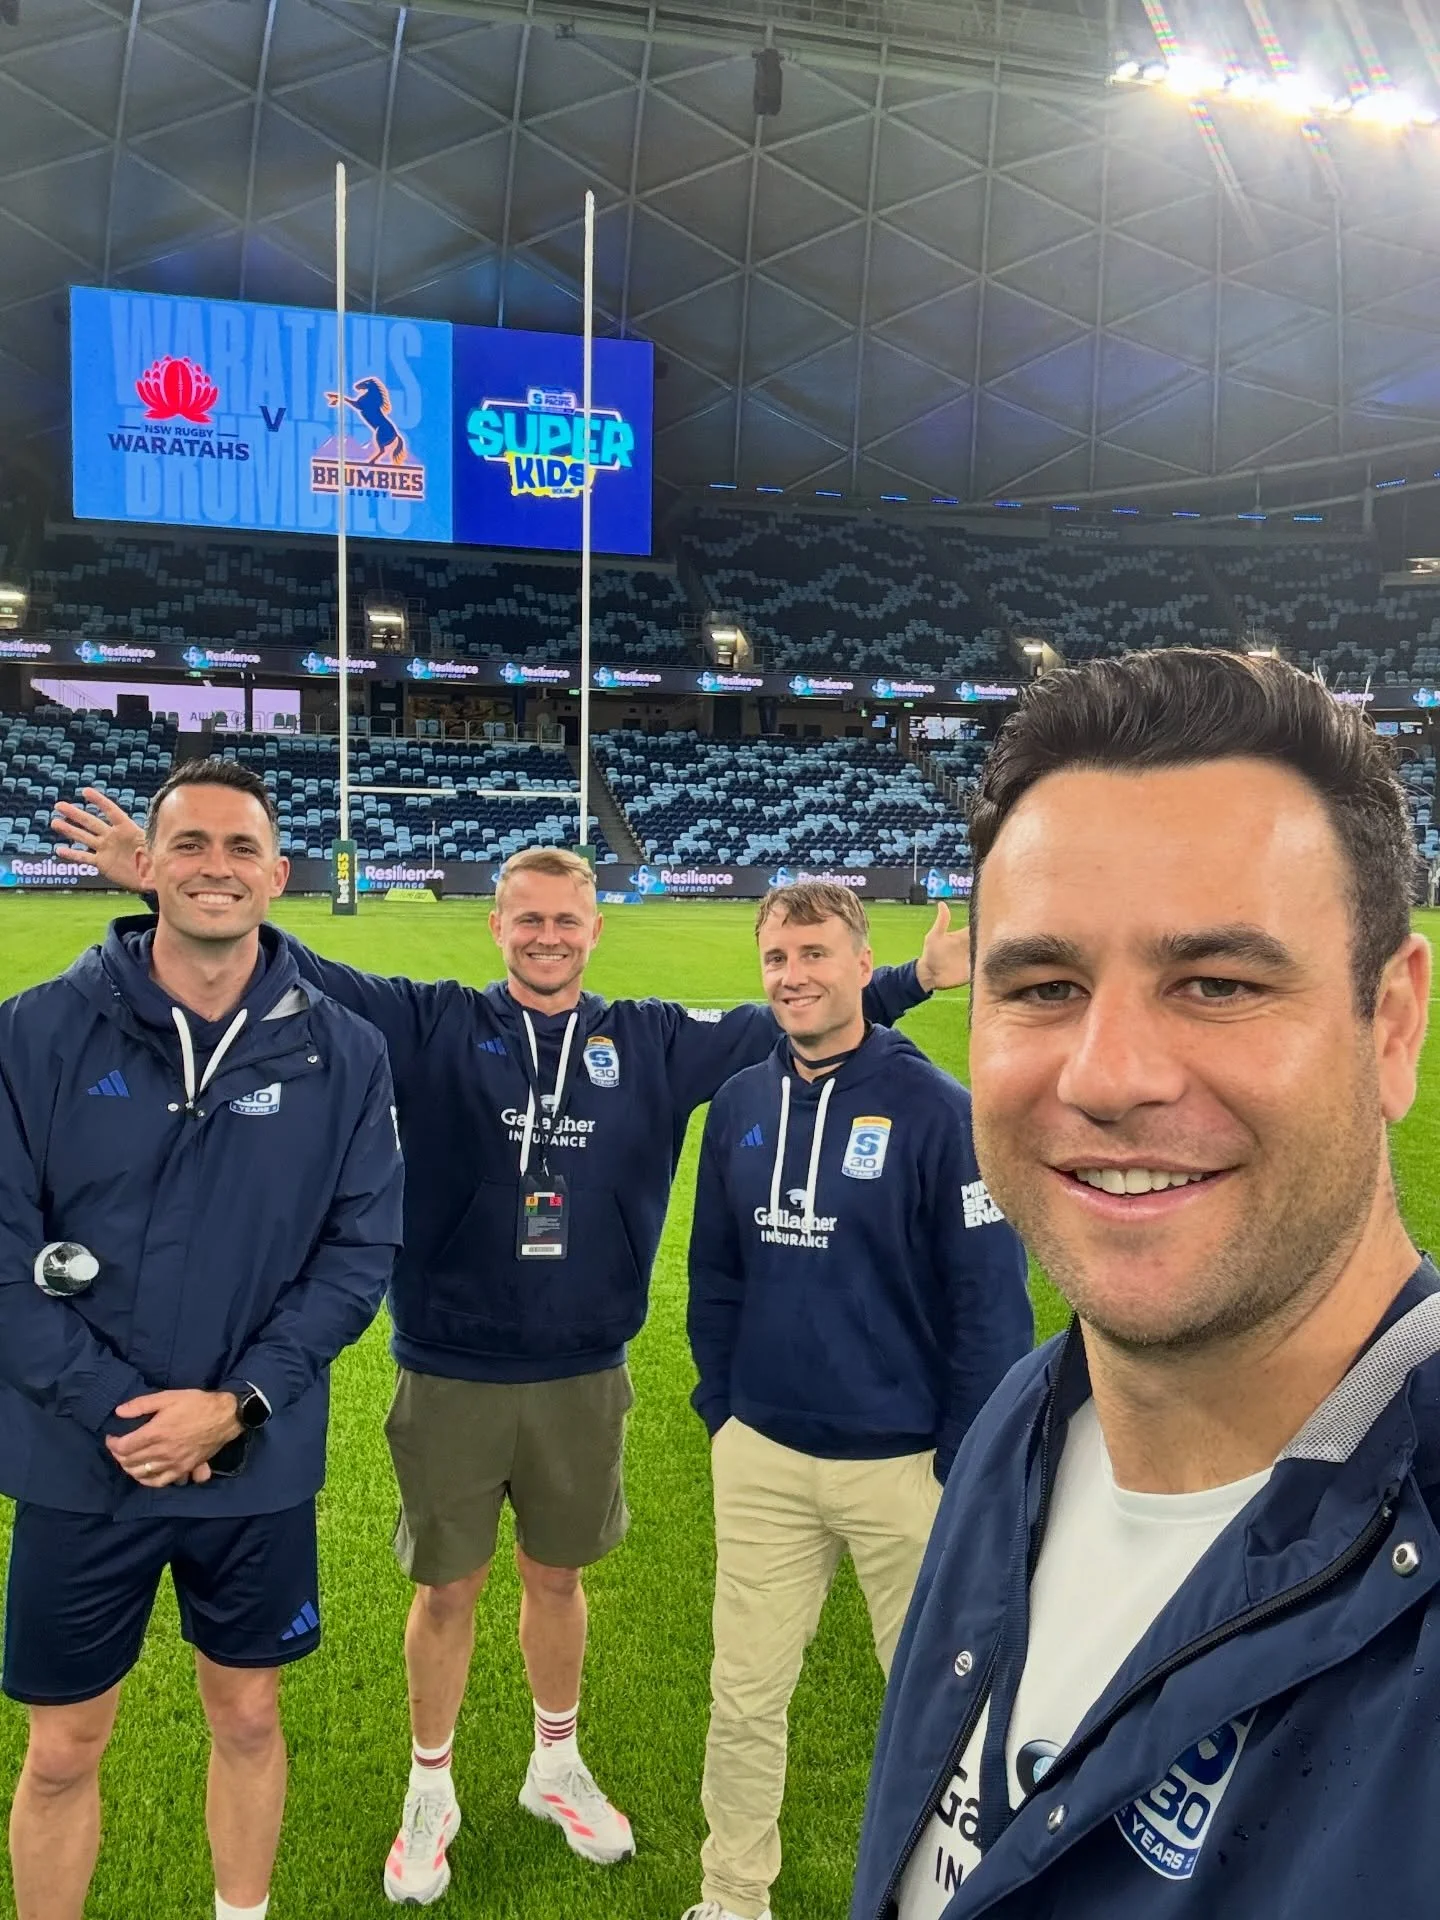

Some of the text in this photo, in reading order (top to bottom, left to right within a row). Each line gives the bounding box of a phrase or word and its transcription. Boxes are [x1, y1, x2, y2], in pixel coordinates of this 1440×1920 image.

[144, 424, 214, 439] NSW RUGBY
[468, 410, 634, 468] SUPER
[108, 432, 250, 462] WARATAHS
[514, 456, 588, 489] KIDS
[0, 638, 51, 654] esilience
[100, 643, 156, 658] Resilience
[206, 649, 261, 664] Resilience
[428, 660, 479, 675] Resilience
[521, 665, 570, 679] Resilience
[11, 855, 99, 877] Resilience
[365, 861, 445, 881] Resilience
[661, 866, 733, 885] Resilience
[336, 852, 349, 904] bet365
[594, 1068, 616, 1079] 30
[849, 1156, 876, 1169] 30
[1141, 1771, 1211, 1841] 30
[1132, 1813, 1185, 1870] YEARS
